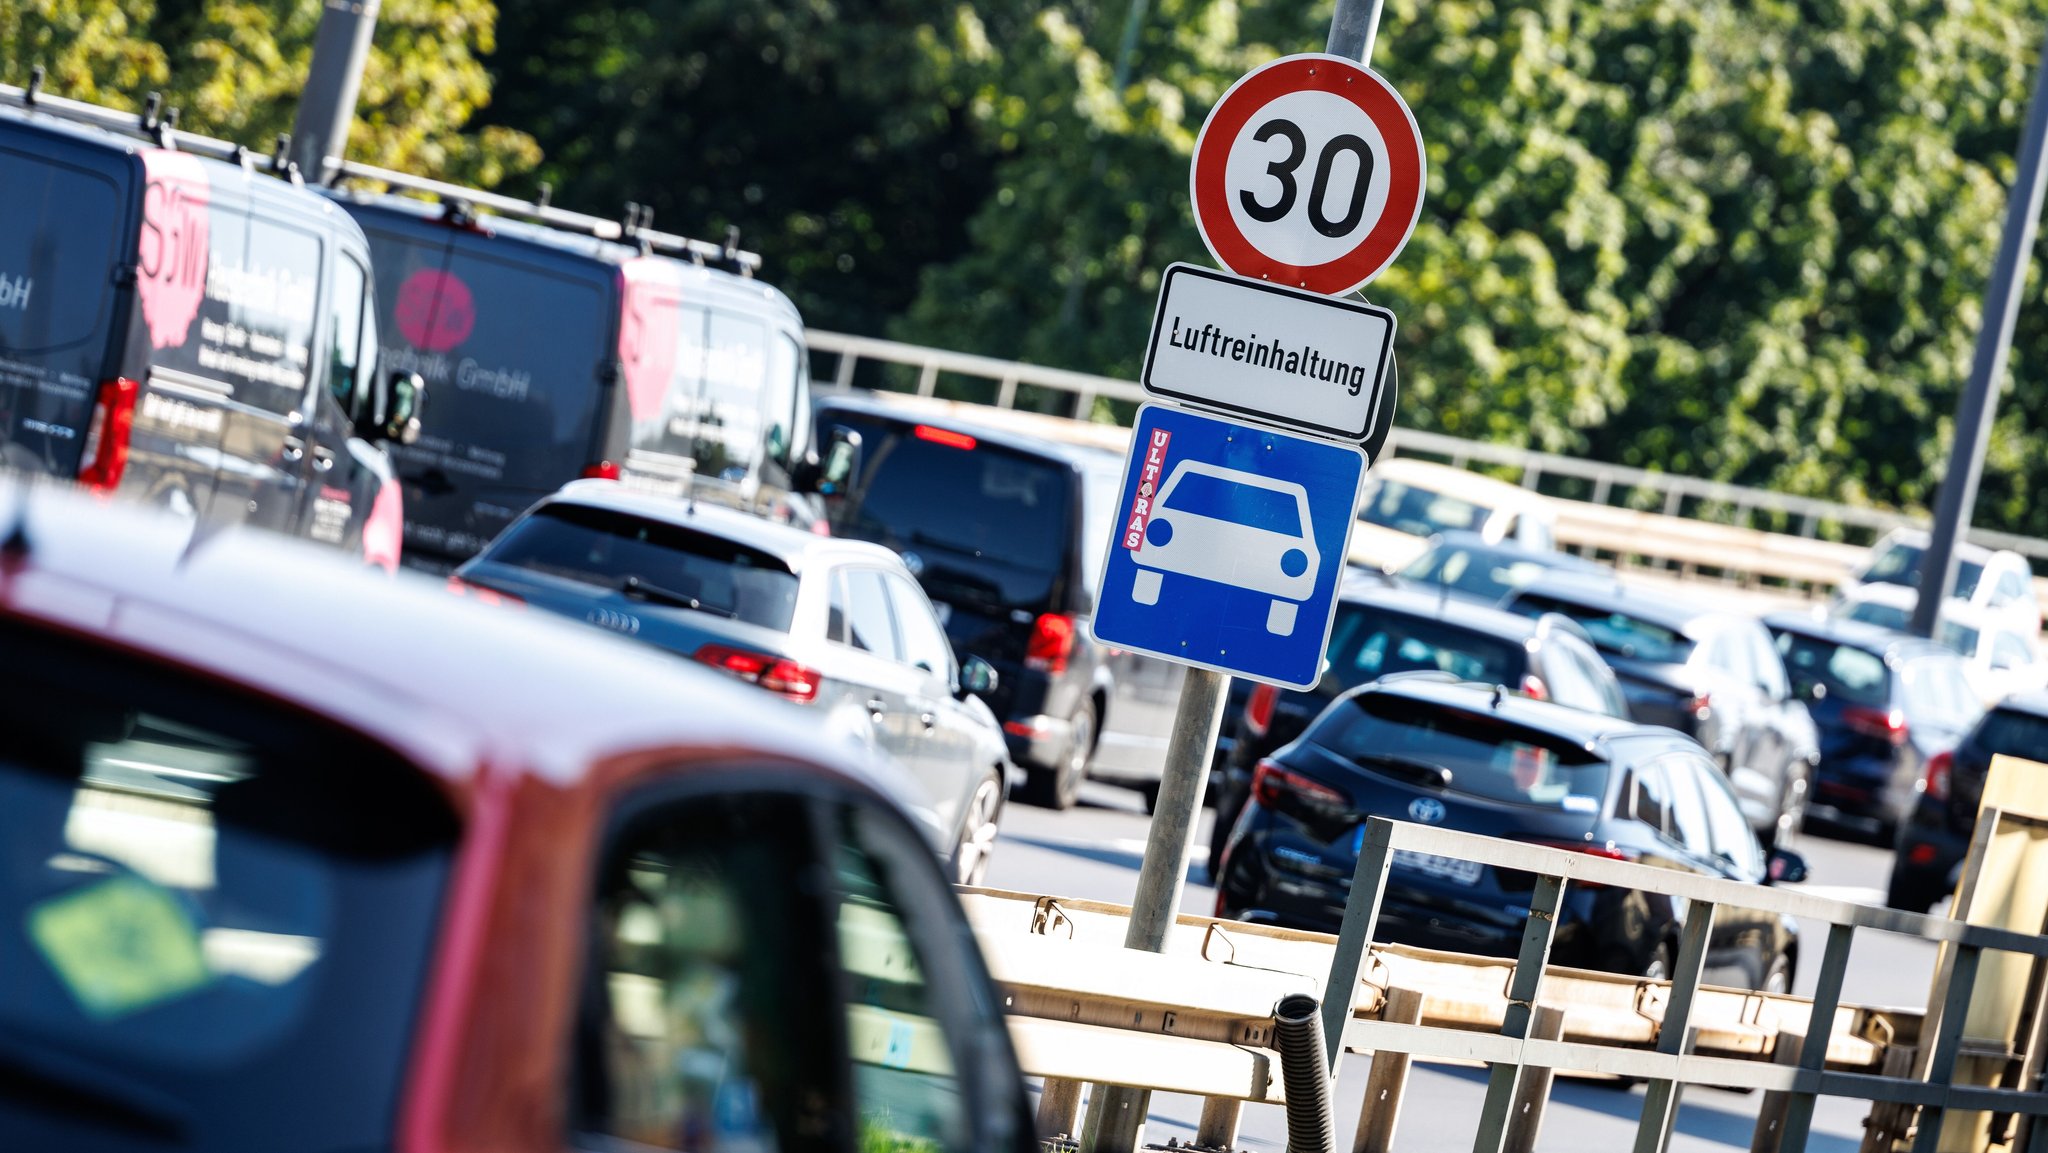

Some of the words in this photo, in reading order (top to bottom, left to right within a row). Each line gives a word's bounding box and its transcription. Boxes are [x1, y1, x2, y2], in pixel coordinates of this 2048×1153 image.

[1240, 118, 1375, 239] 30
[456, 357, 532, 402] GmbH
[1168, 316, 1366, 397] Luftreinhaltung
[1126, 431, 1168, 548] ULTRAS
